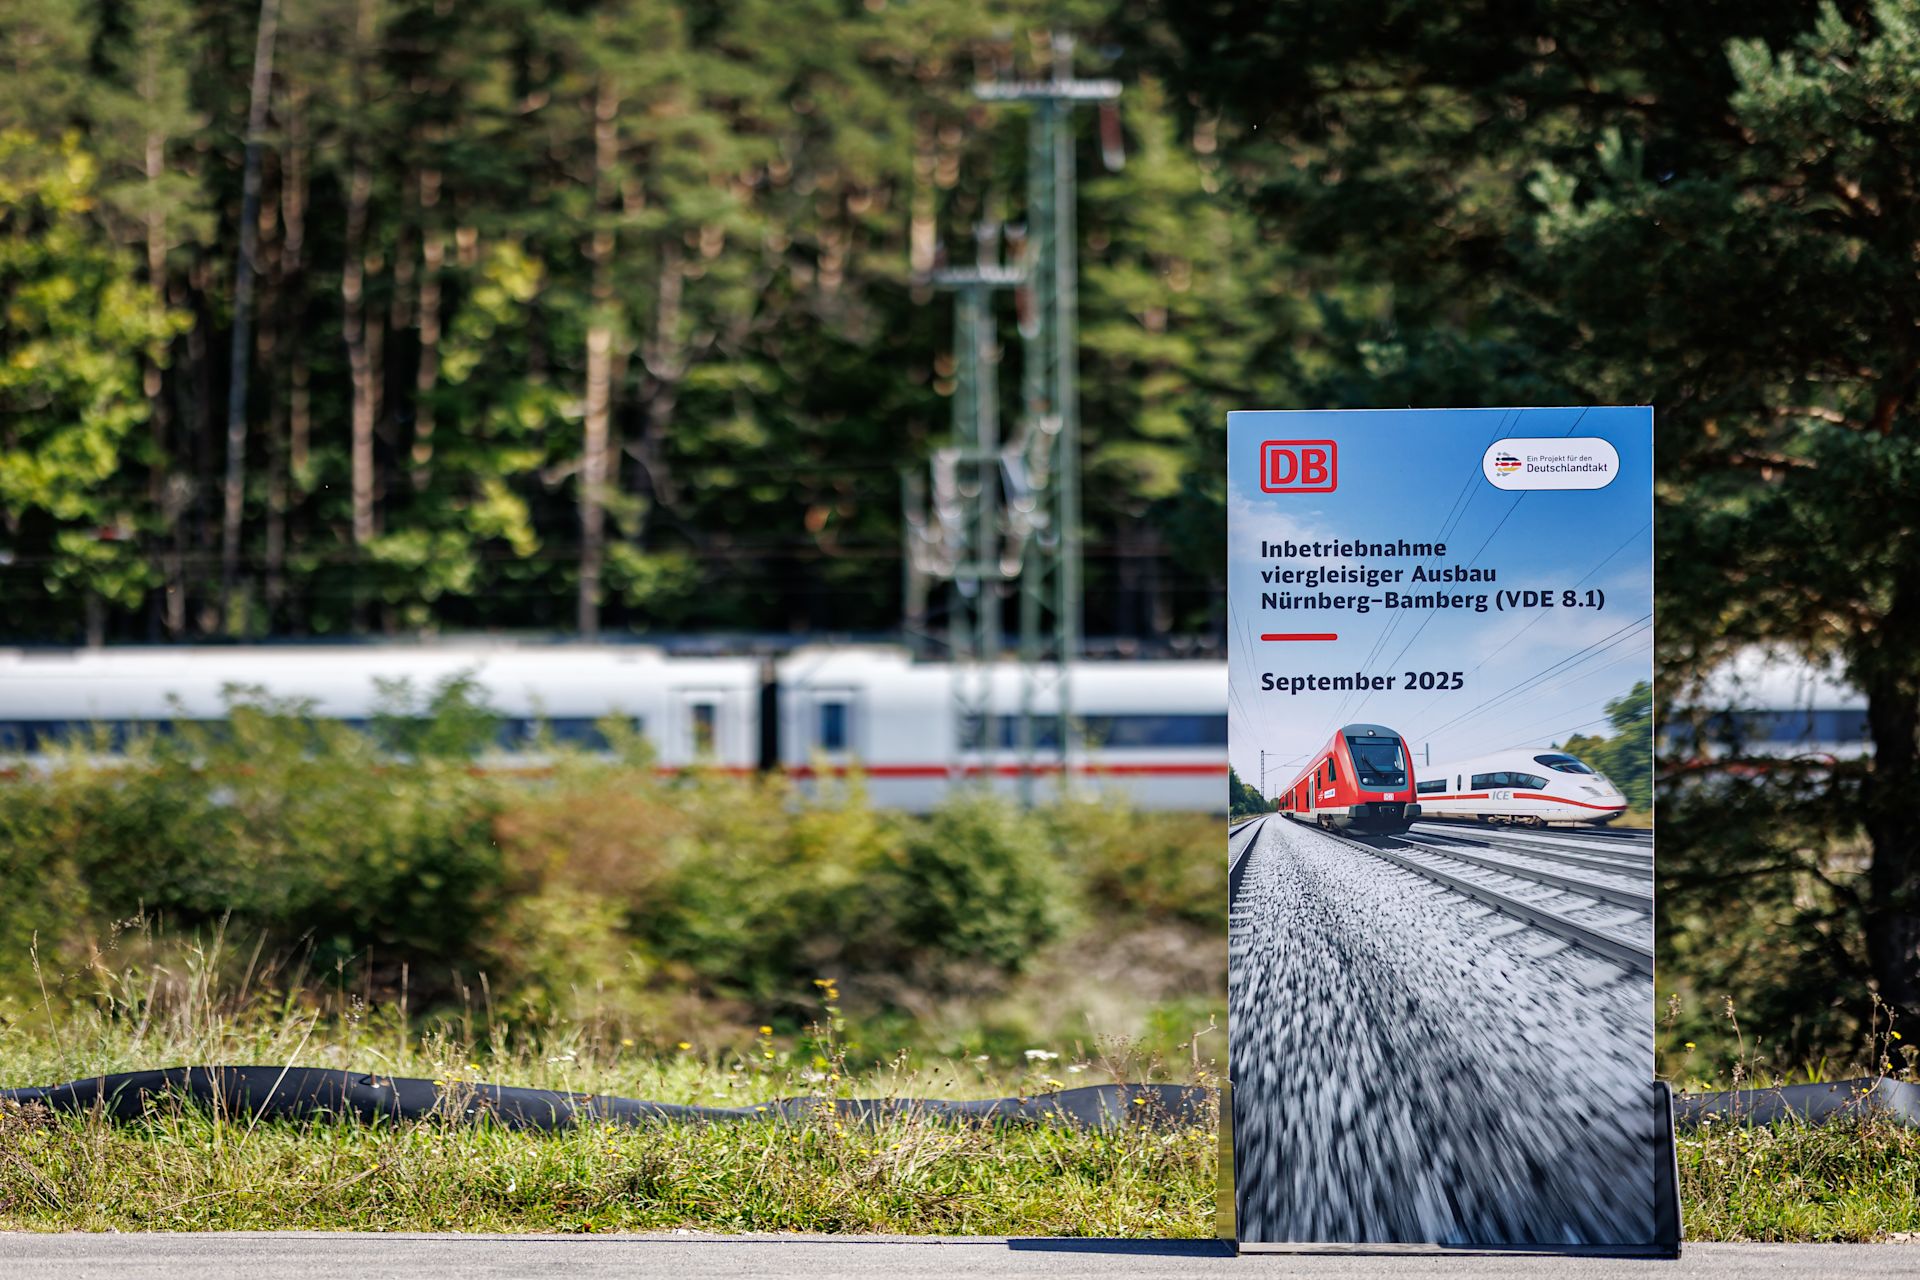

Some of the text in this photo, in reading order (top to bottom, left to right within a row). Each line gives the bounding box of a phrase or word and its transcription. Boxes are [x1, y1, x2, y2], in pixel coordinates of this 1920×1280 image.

[1271, 449, 1328, 484] DB
[1527, 463, 1608, 472] Deutschlandtakt
[1539, 455, 1566, 463] Projekt
[1261, 539, 1447, 558] Inbetriebnahme
[1260, 564, 1496, 588] viergleisiger Ausbau
[1495, 589, 1554, 612] (VDE
[1562, 588, 1605, 611] 8.1)
[1261, 671, 1464, 696] September 2025
[1492, 790, 1510, 801] ICE
